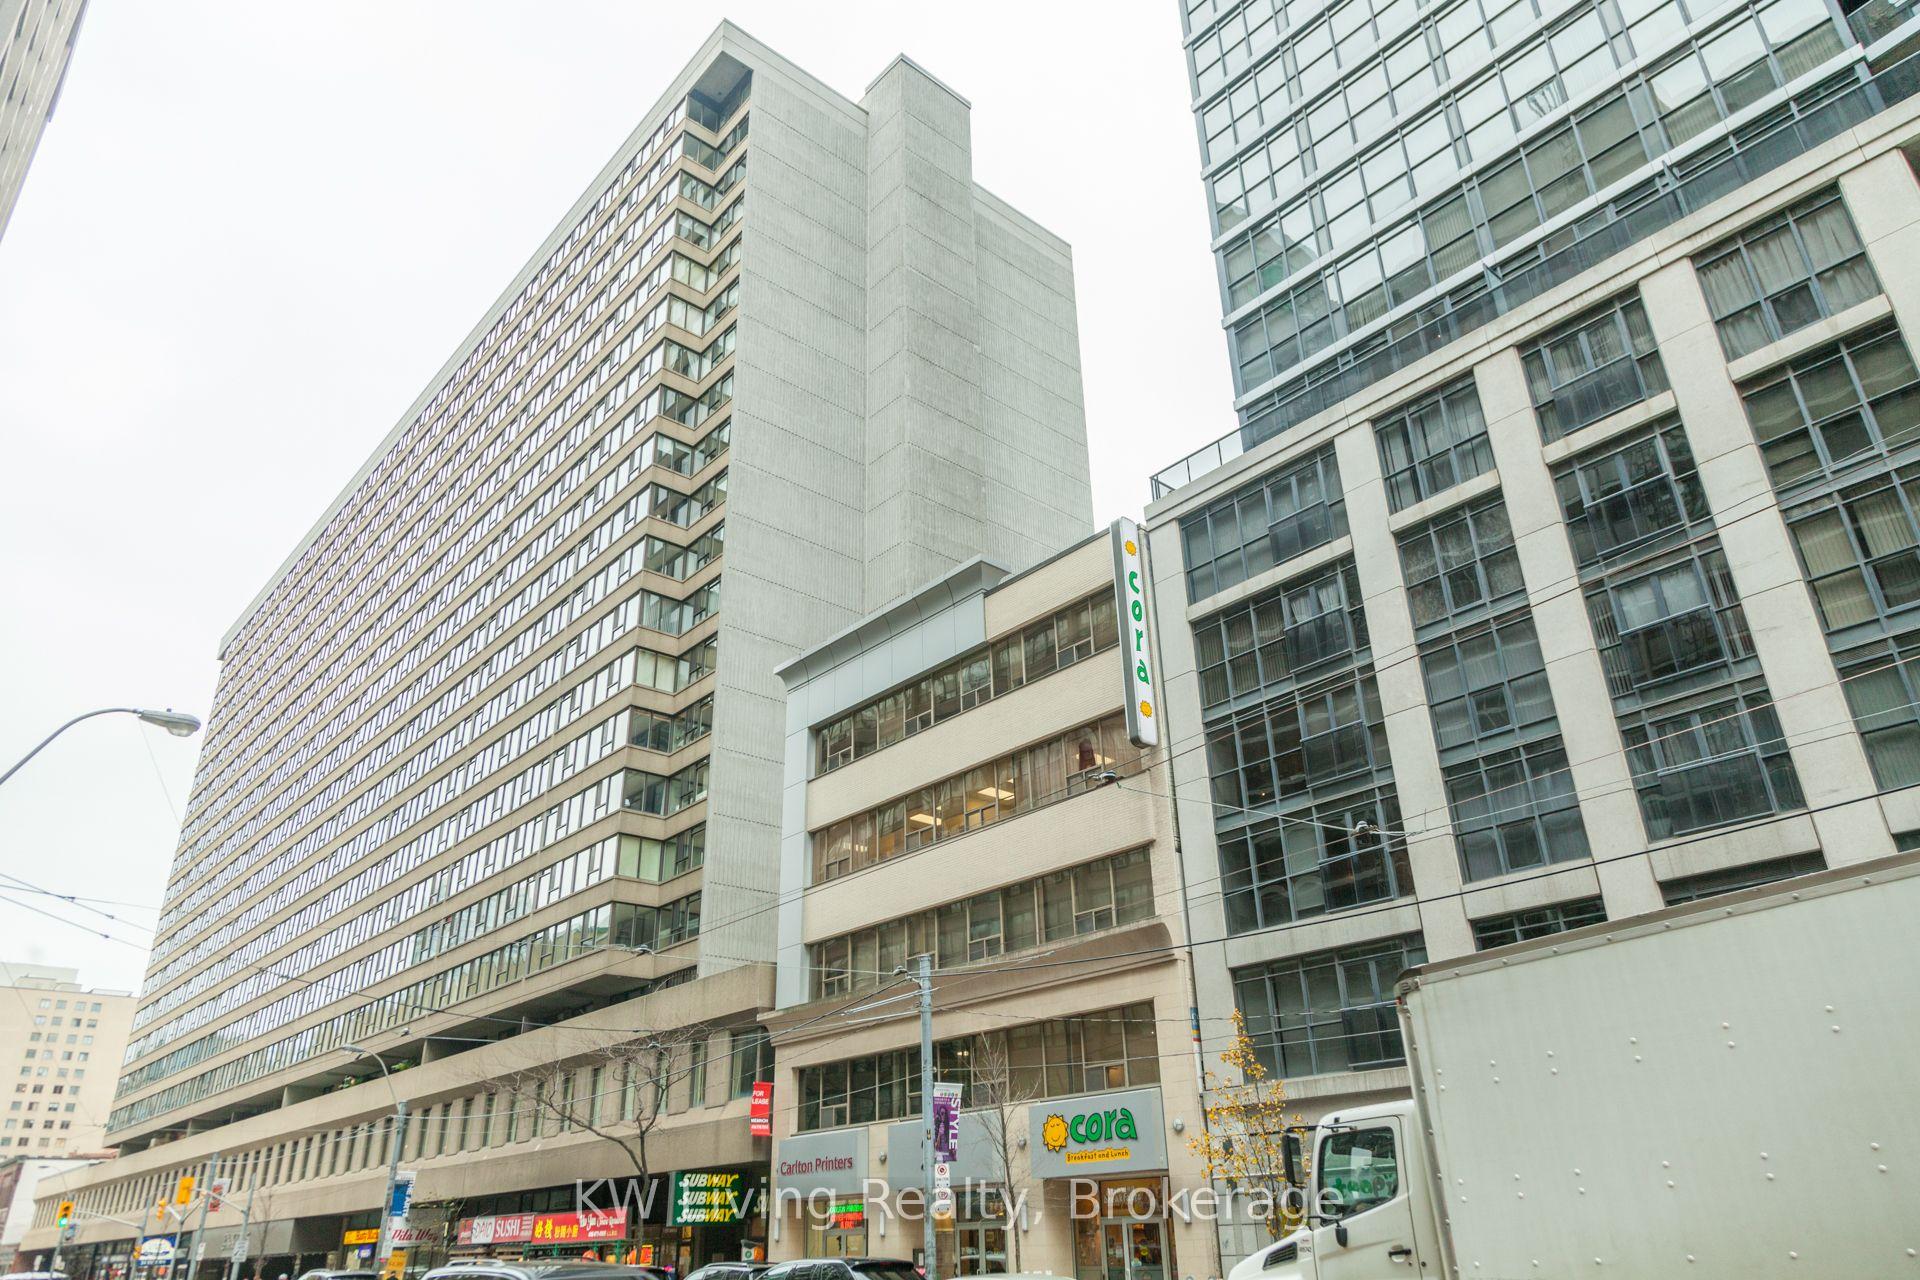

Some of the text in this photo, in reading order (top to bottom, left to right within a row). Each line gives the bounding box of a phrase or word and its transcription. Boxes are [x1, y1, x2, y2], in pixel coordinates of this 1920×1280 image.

[1128, 571, 1150, 685] cora
[949, 1097, 960, 1150] STYLE
[1070, 1108, 1138, 1143] cora
[1067, 1149, 1129, 1163] Breakfast and Lunch
[781, 1156, 853, 1176] Carlton Printers
[679, 1173, 739, 1188] SUBWAY
[677, 1190, 739, 1206] SUBWAY
[676, 1207, 738, 1223] SUBWAY
[392, 1228, 413, 1241] Pita
[415, 1228, 440, 1244] Way
[495, 1218, 521, 1238] SUSHI
